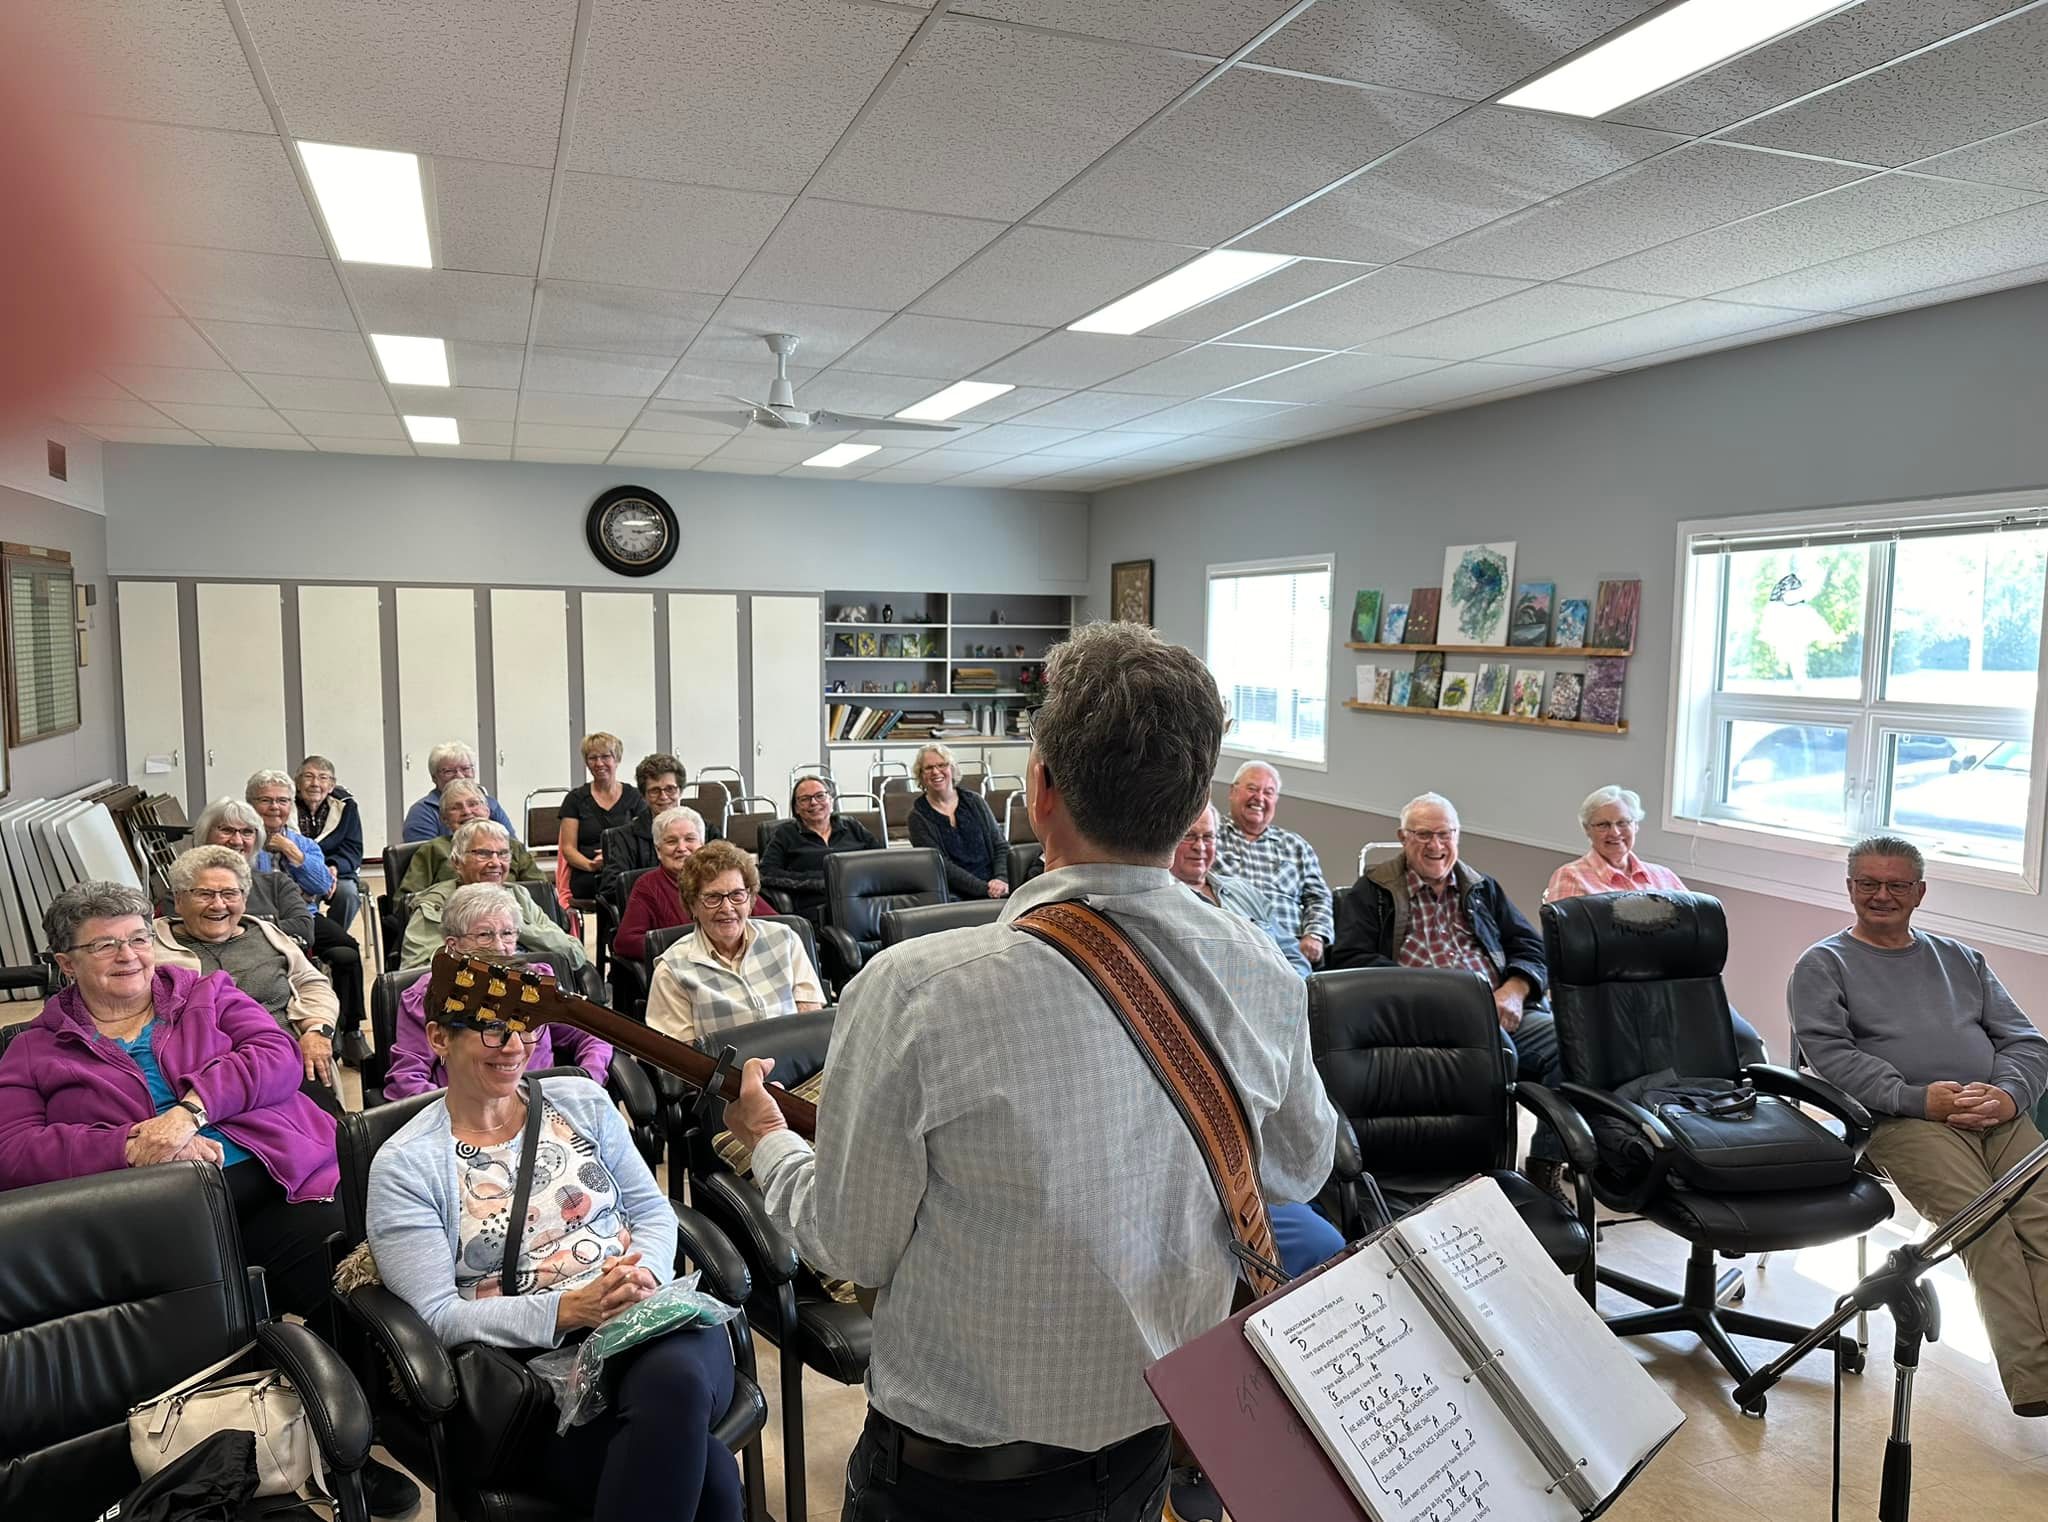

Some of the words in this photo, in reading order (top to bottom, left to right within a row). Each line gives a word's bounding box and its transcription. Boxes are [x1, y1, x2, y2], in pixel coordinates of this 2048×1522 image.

[1297, 1339, 1309, 1352] D
[1332, 1360, 1345, 1377] G
[1328, 1387, 1339, 1401] G
[1359, 1397, 1369, 1411] G
[1378, 1384, 1391, 1399] G
[1373, 1415, 1384, 1427] G
[1423, 1372, 1433, 1386] A
[1348, 1424, 1358, 1434] WE
[1356, 1417, 1367, 1429] ARE
[1364, 1409, 1377, 1422] MANY
[1376, 1402, 1386, 1413] AND
[1391, 1390, 1401, 1402] ARE
[1428, 1415, 1442, 1429] A
[1421, 1435, 1438, 1451] PLACE
[1377, 1449, 1389, 1461] ARE
